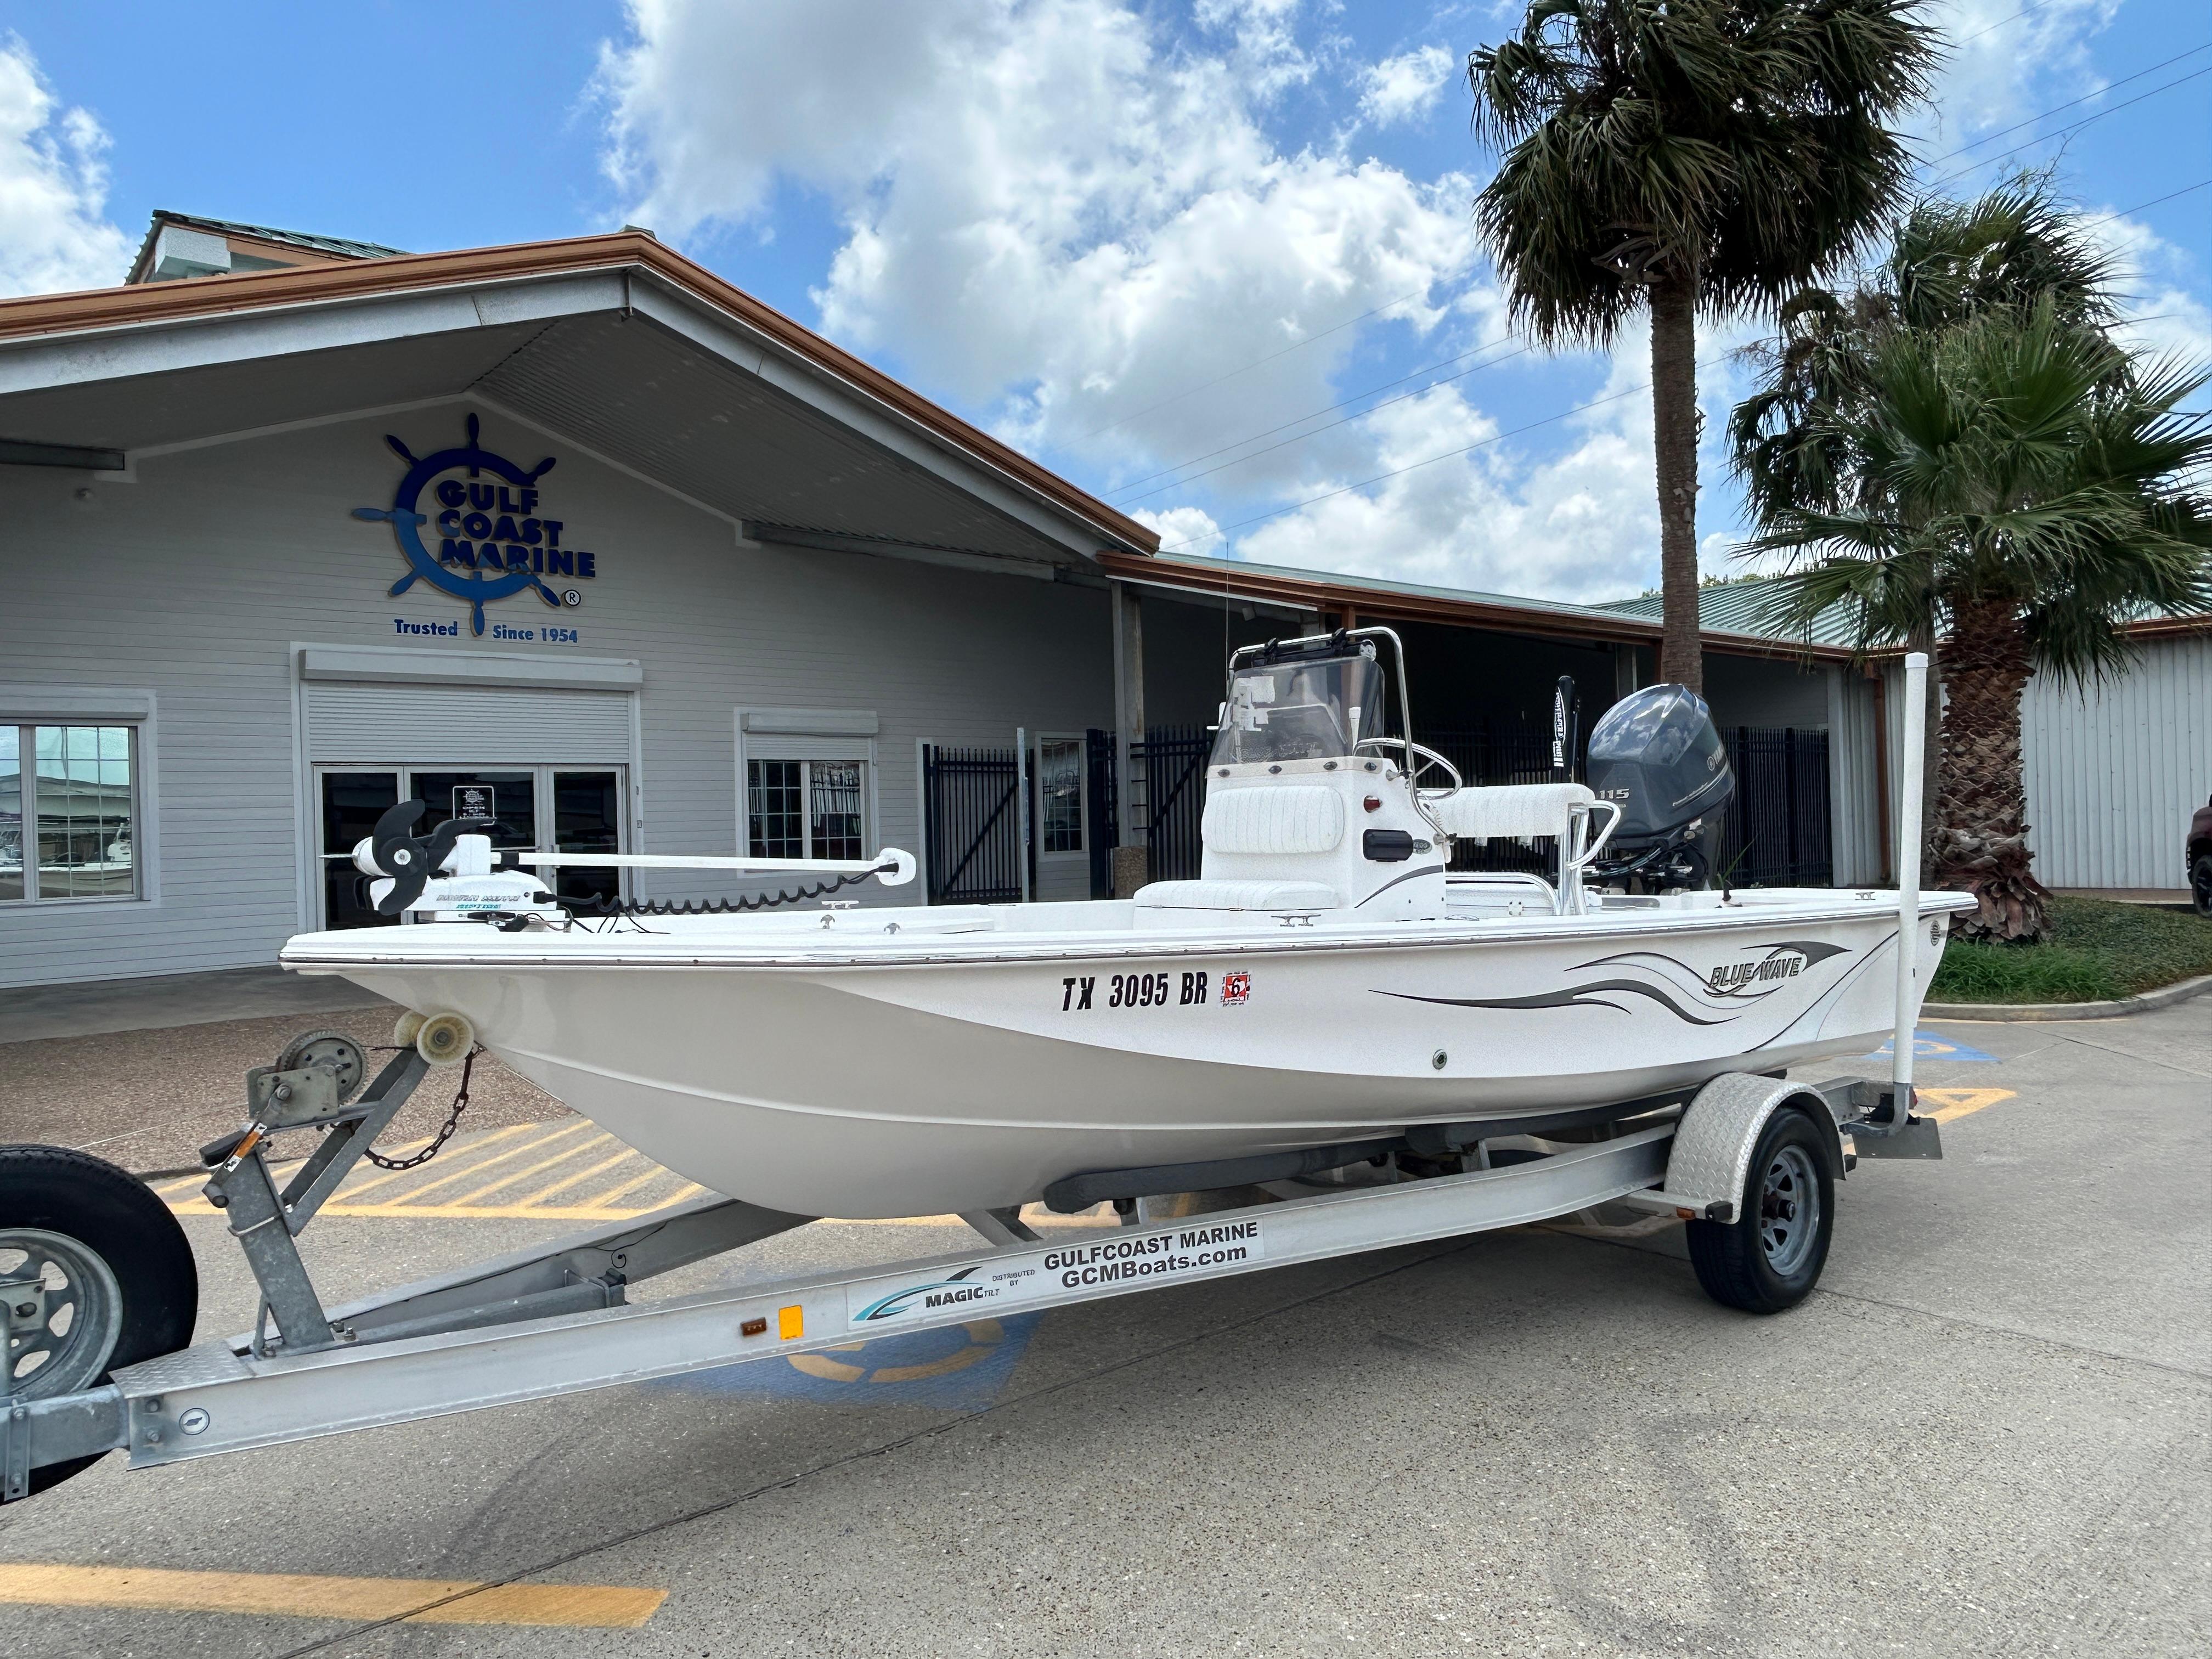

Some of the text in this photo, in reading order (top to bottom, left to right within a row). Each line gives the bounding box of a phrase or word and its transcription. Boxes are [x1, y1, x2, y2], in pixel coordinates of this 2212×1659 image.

[438, 479, 539, 515] GULF
[439, 509, 563, 547] COAST
[440, 539, 596, 578] MARINE
[394, 619, 578, 643] Trusted Since 1954
[1599, 788, 1630, 799] 115
[1231, 977, 1241, 997] 6
[1710, 957, 1802, 987] BLUE WAVE
[1062, 977, 1096, 1012] TX
[1109, 973, 1169, 1008] 3095
[1180, 972, 1207, 1006] BR
[1044, 1222, 1258, 1271] GULFCOAST MARINE
[992, 1269, 1035, 1282] DISTRIBUTED
[1062, 1246, 1247, 1288] GCMBoats.com
[925, 1286, 984, 1308] MAGIC
